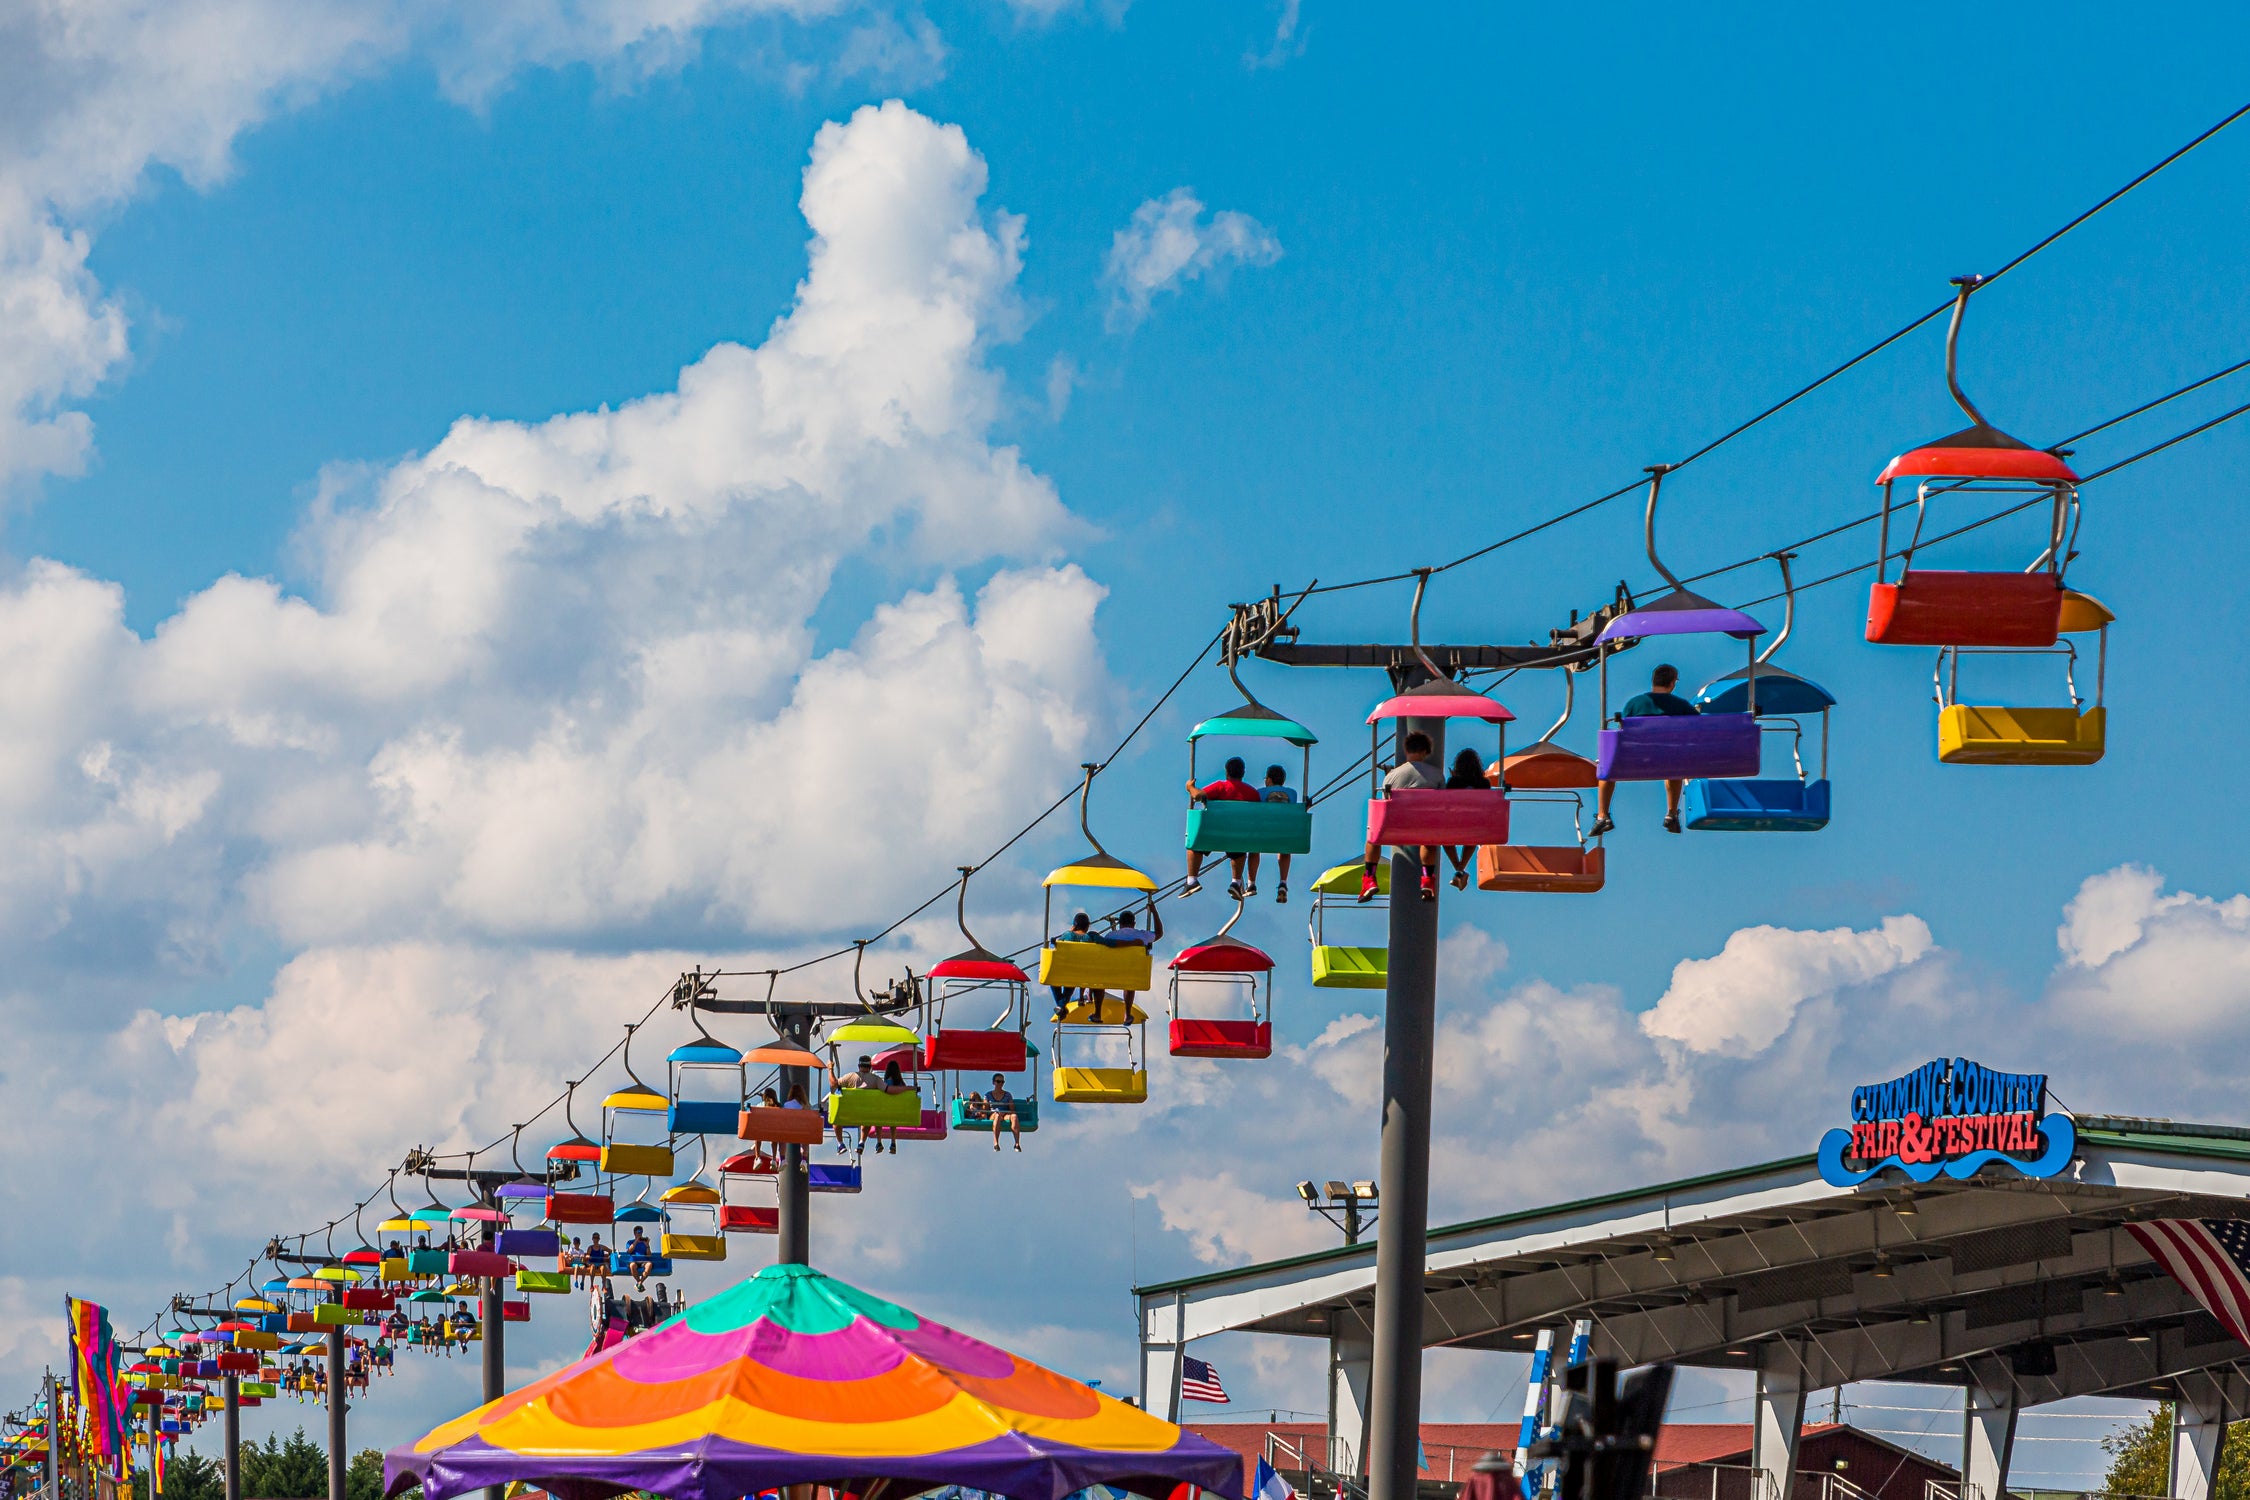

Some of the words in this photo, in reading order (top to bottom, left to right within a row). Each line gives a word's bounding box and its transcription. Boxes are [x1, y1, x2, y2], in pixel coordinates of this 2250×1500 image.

[1851, 1057, 1946, 1121] CUMMING
[1950, 1057, 2043, 1116] COUNTRY
[1851, 1122, 1899, 1159] FAIR
[1900, 1112, 1932, 1164] &
[1932, 1113, 2038, 1155] FESTIVAL
